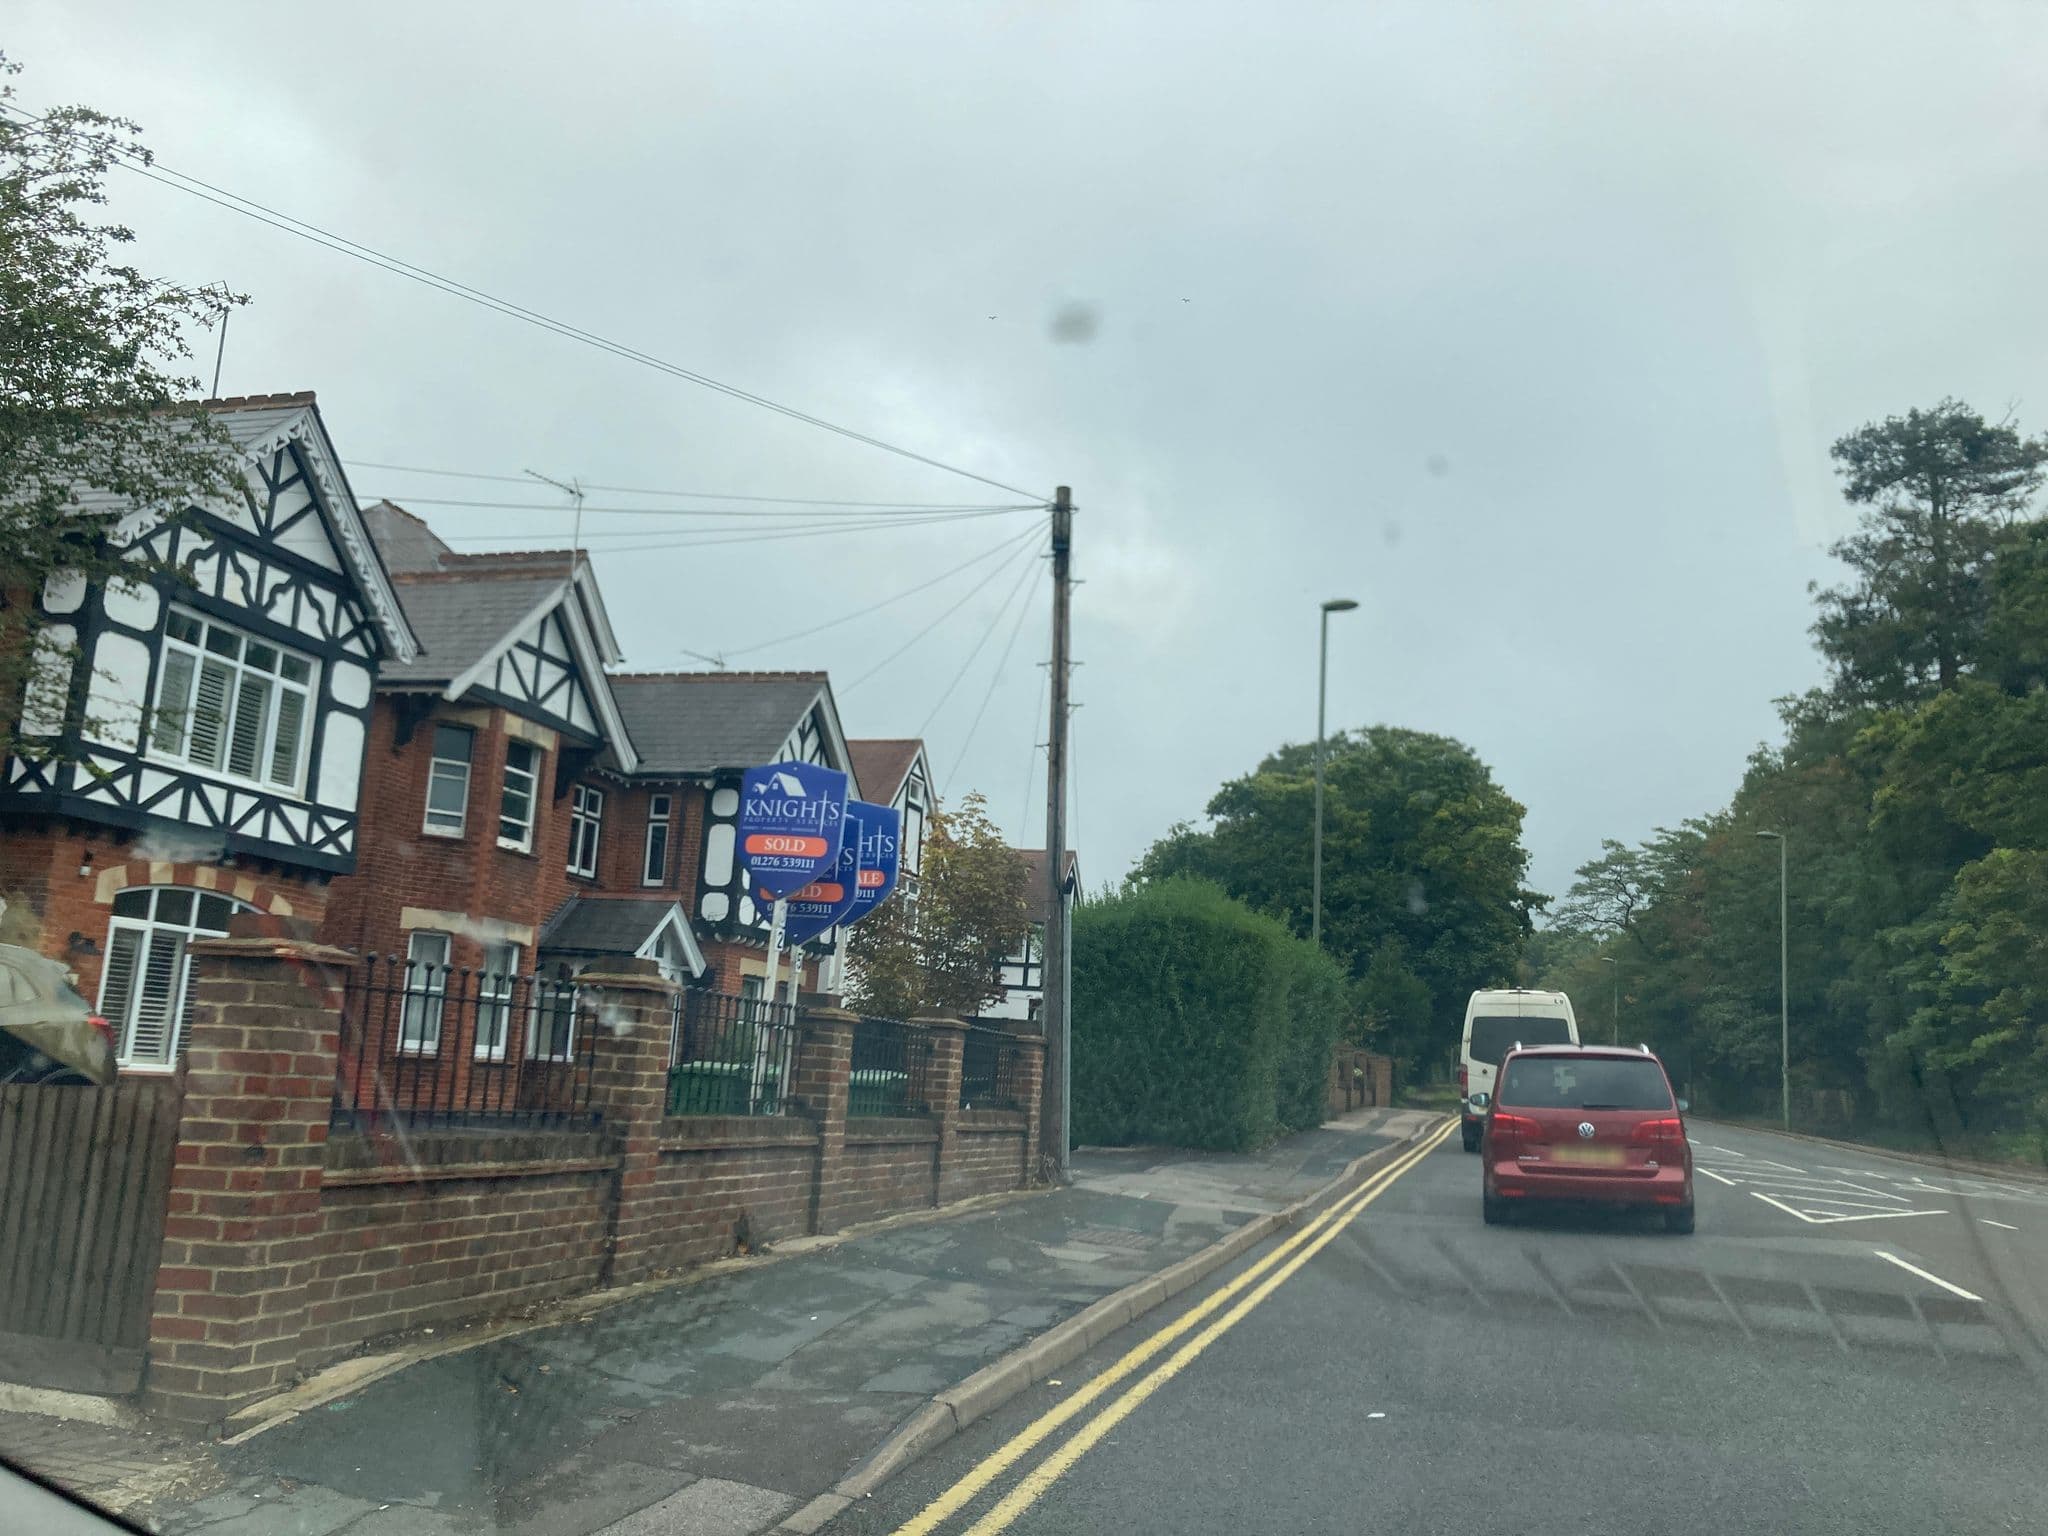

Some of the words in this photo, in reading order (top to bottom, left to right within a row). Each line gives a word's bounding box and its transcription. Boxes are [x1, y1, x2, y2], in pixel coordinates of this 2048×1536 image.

[744, 790, 841, 836] KNIGHTS
[764, 837, 806, 853] SOLD
[750, 856, 780, 867] 01276
[781, 857, 815, 869] 539111
[800, 885, 823, 898] LD
[799, 903, 832, 914] 539111
